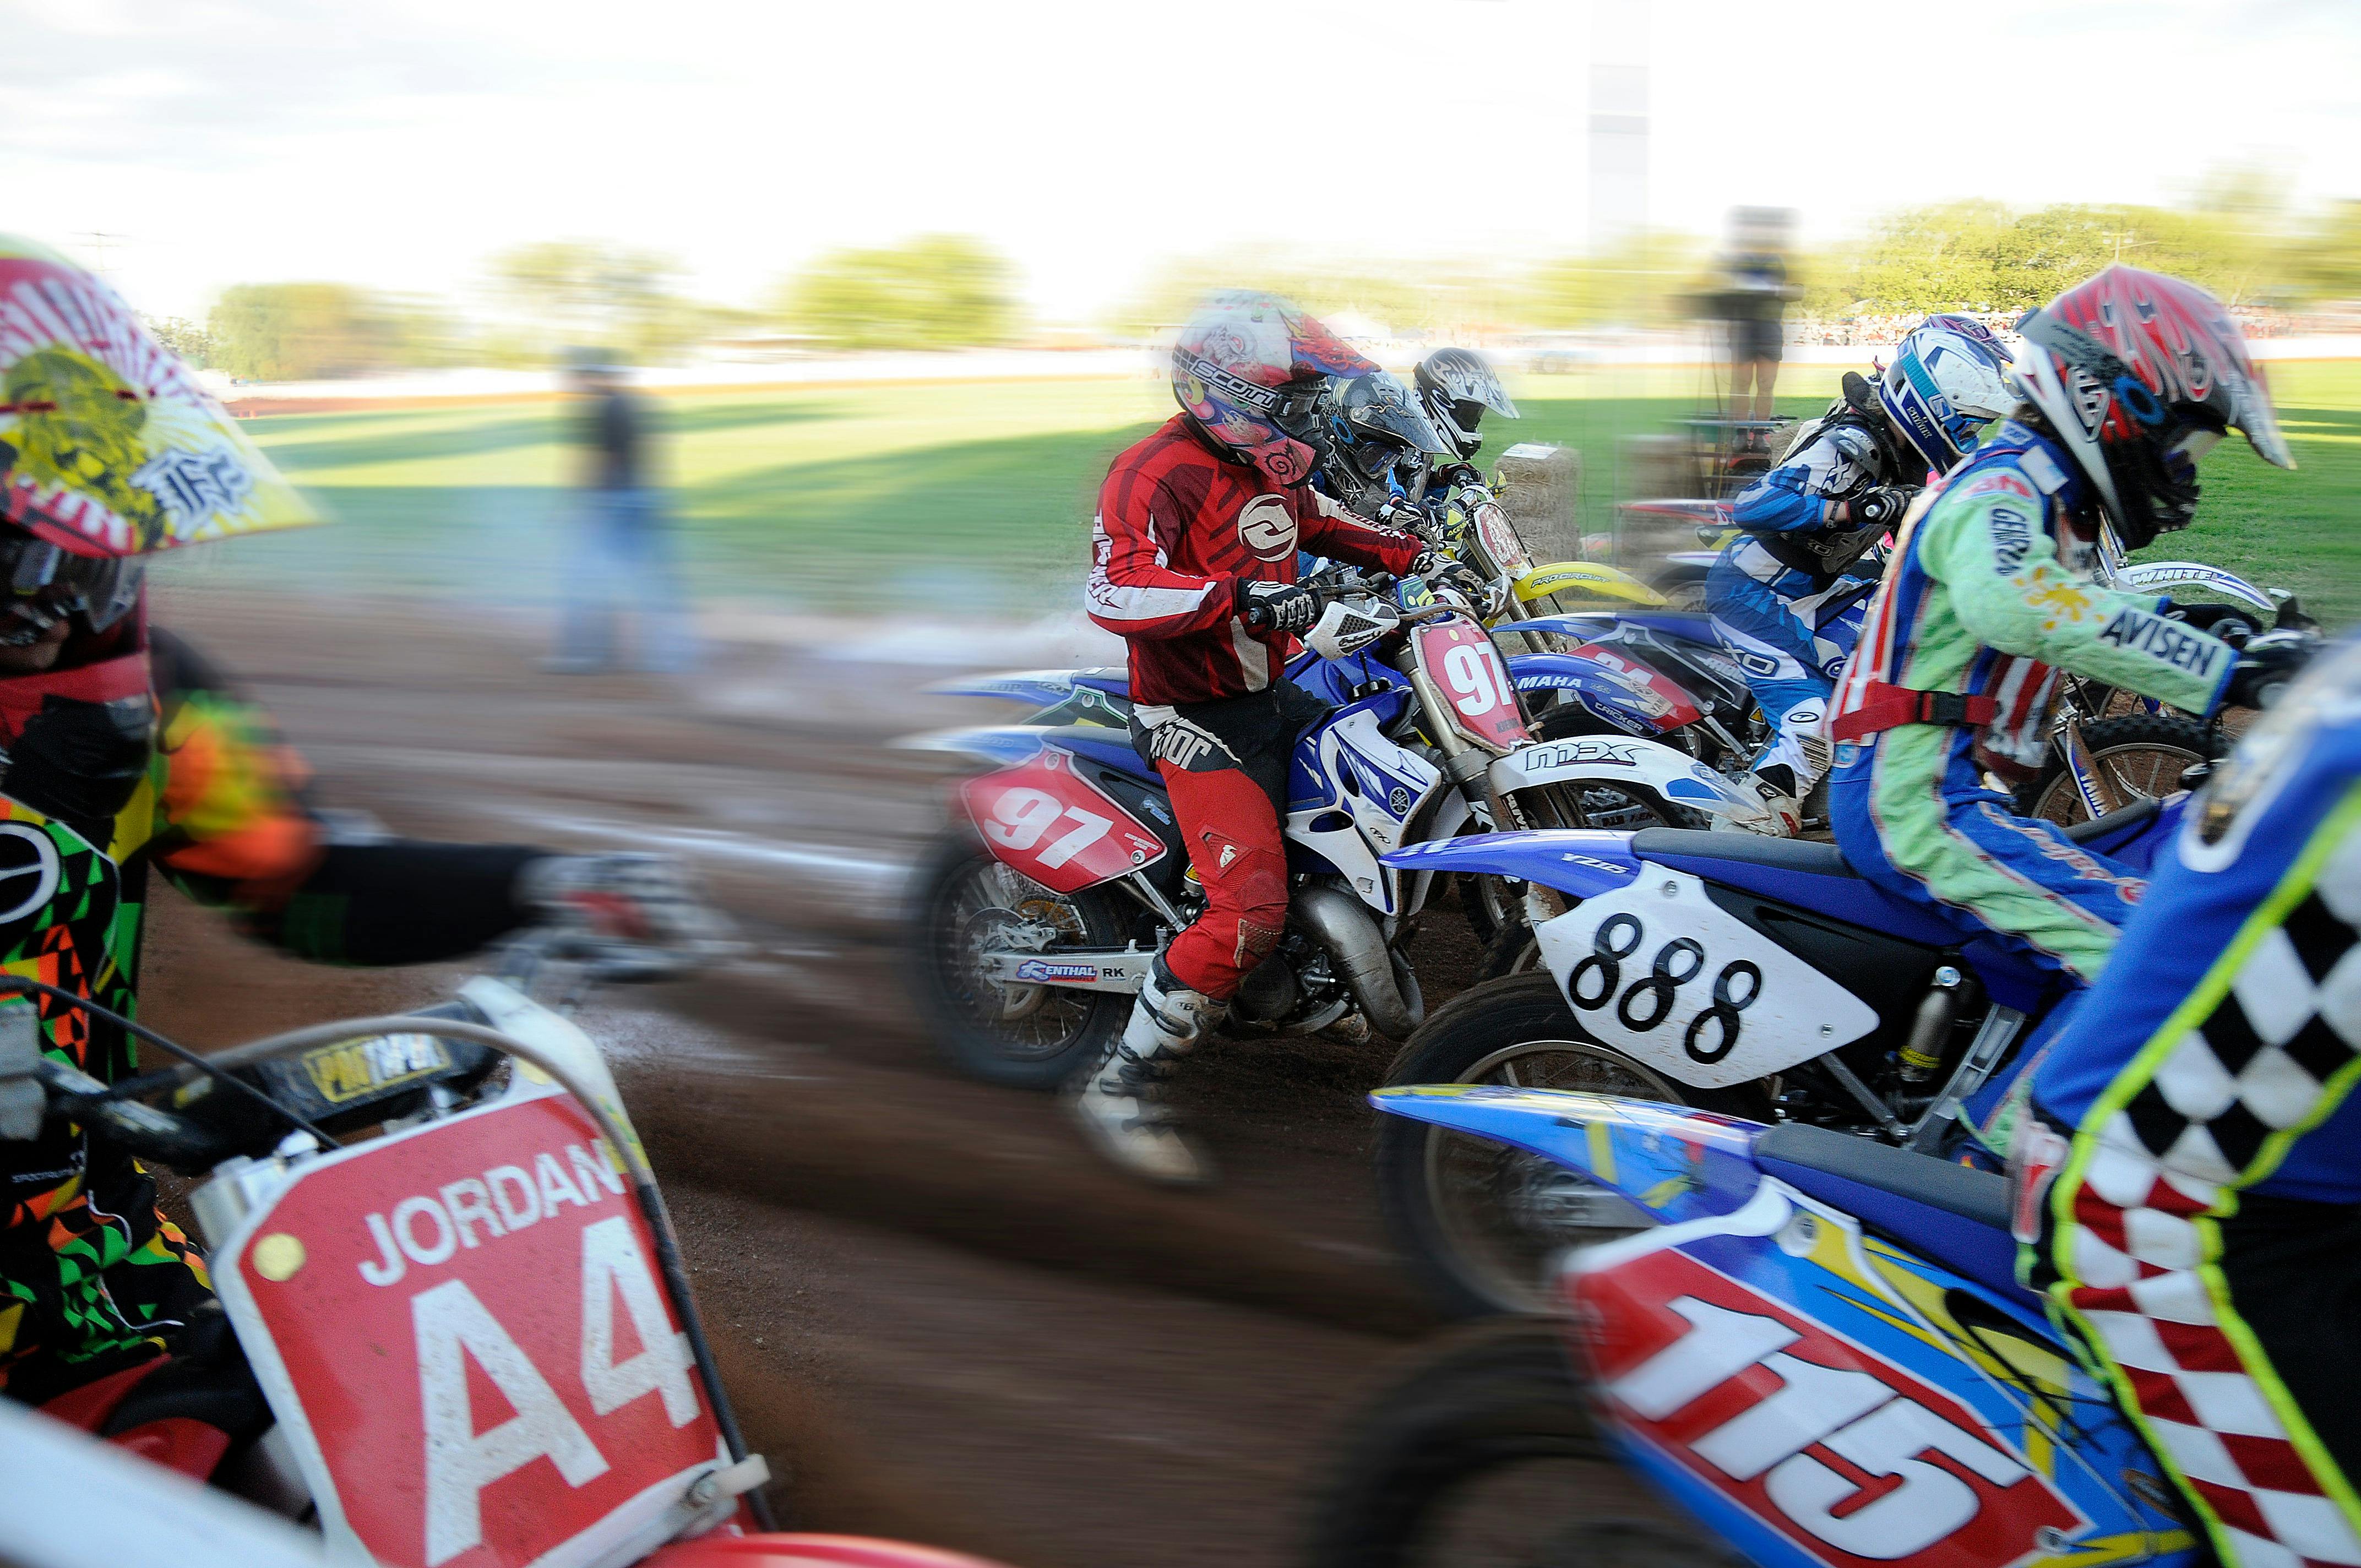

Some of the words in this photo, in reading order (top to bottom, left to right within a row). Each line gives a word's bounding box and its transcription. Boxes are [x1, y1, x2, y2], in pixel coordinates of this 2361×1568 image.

[1195, 361, 1277, 407] SCOTT
[1531, 574, 1558, 589] PRO
[1558, 572, 1610, 584] CIRCUIT
[2101, 609, 2218, 676] AVISEN
[1444, 641, 1513, 716] 97
[1507, 676, 1582, 692] MAHA
[983, 787, 1114, 870] 97
[1018, 961, 1096, 981] RENTHAL
[1103, 968, 1125, 977] RK
[1569, 913, 1762, 1065] 888
[357, 1139, 624, 1287] JORDAN
[412, 1216, 700, 1567] A4
[1608, 1294, 2034, 1561] 115
